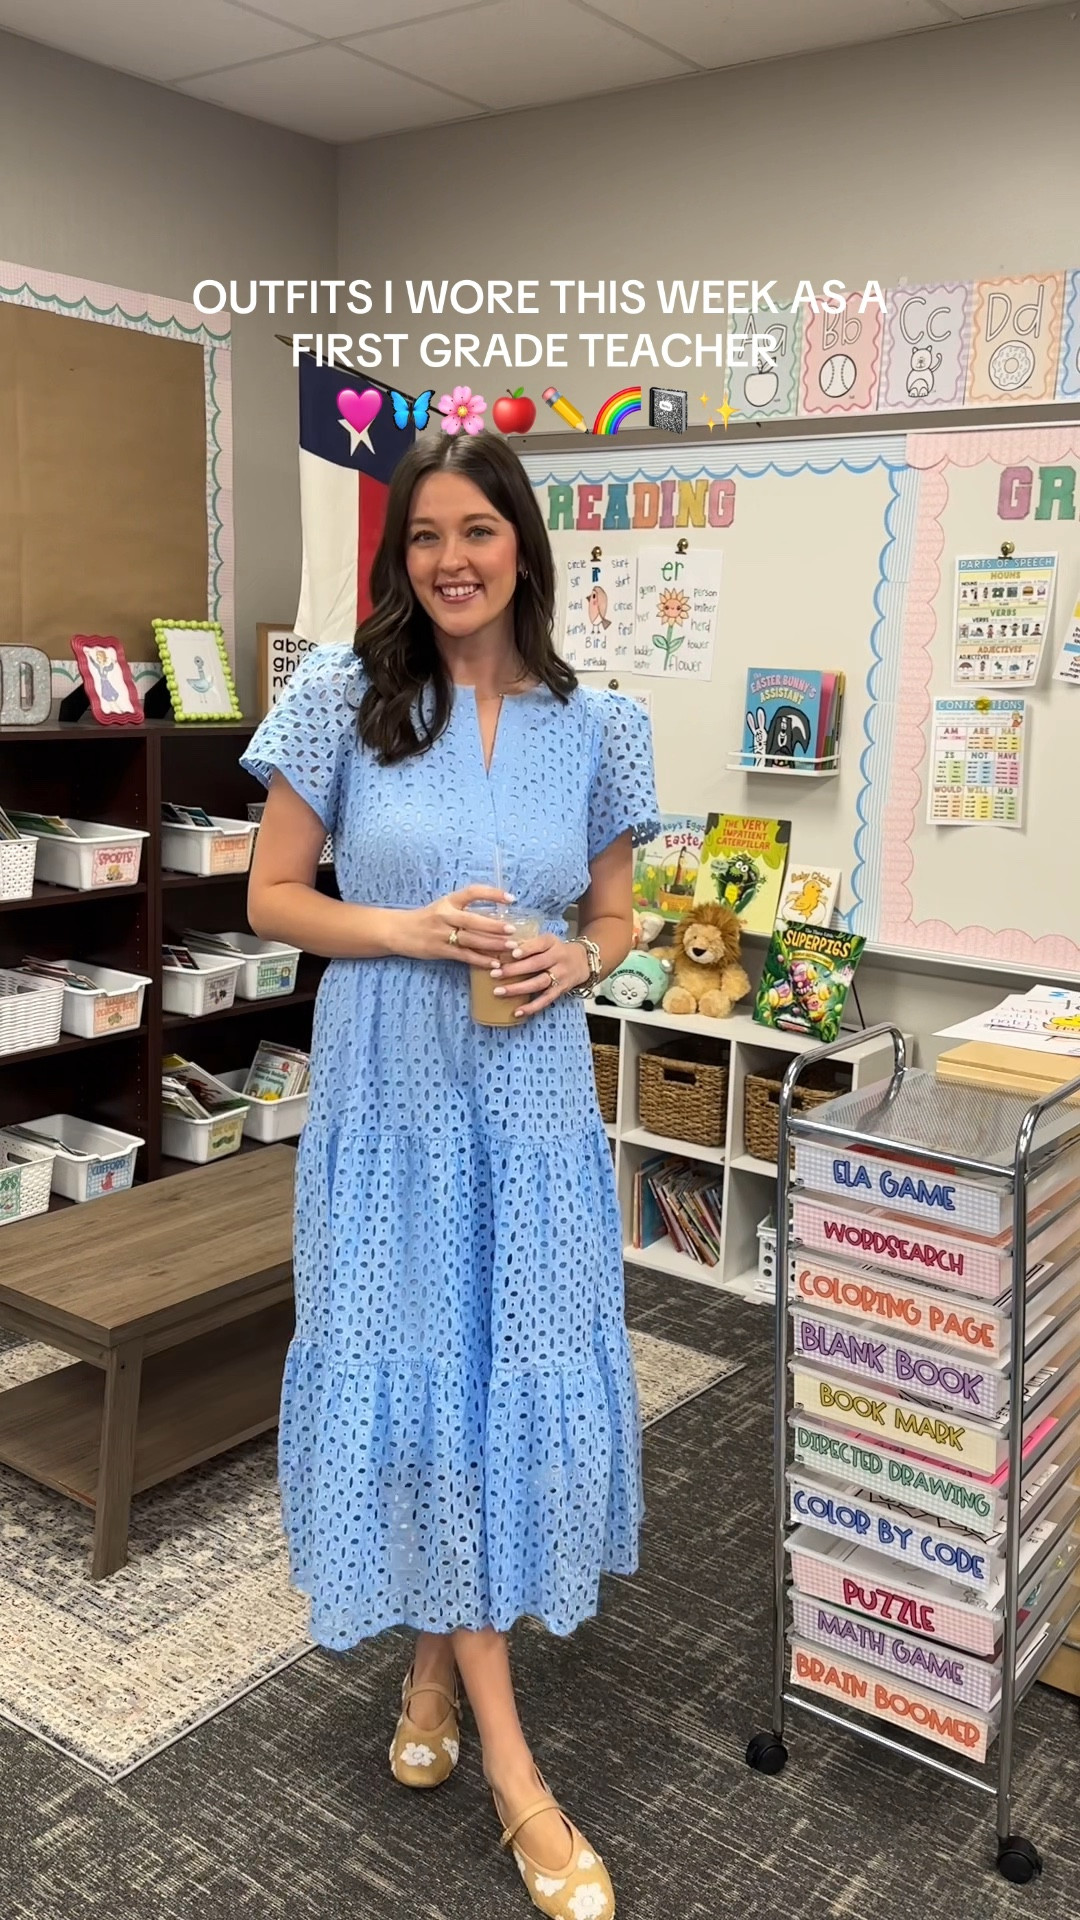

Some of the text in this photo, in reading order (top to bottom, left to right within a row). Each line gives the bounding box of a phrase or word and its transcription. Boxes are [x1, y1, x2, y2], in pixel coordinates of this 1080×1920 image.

[900, 297, 951, 344] Cc
[985, 284, 1044, 342] Dd
[997, 465, 1080, 520] GR
[547, 479, 736, 531] READING
[661, 561, 684, 581] er
[960, 557, 1052, 569] PARTS OF SPEECH
[990, 571, 1021, 580] NOUNS
[990, 608, 1017, 617] VERBS
[585, 635, 607, 649] Bird
[977, 645, 1022, 654] ADJECTIVES
[669, 655, 702, 672] flower
[750, 675, 817, 699] EASTER BUNNY'S
[760, 687, 805, 705] ASSISTANT
[938, 700, 1023, 710] CONTRTIONS
[973, 727, 989, 735] ARE
[944, 751, 955, 759] IS
[971, 752, 989, 760] NOT
[997, 752, 1017, 760] HAVE
[934, 785, 962, 793] WOULD
[967, 786, 988, 794] WILL
[997, 787, 1014, 795] HAD
[724, 819, 769, 831] THE VERY
[722, 829, 768, 841] IMPATIENT
[716, 838, 771, 850] CATERPILLAR
[98, 851, 133, 866] SPORTS
[784, 929, 851, 958] SUPERPIGS
[91, 1159, 125, 1176] CLIFFORD
[833, 1160, 956, 1211] ELA GAME
[824, 1221, 964, 1276] WORDSEARCH
[800, 1270, 921, 1326] COLORING
[929, 1306, 995, 1348] PAGE
[801, 1322, 983, 1405] BLANK BOOK
[820, 1382, 965, 1451] BOOK MARK
[797, 1427, 883, 1474] DIRECTED
[888, 1460, 991, 1517] DRAWING
[793, 1491, 985, 1580] COLOR BY CODE
[843, 1578, 935, 1632] PUZZLE
[817, 1610, 964, 1686] MATH GAME
[796, 1652, 980, 1748] BRAIN BOOMER
